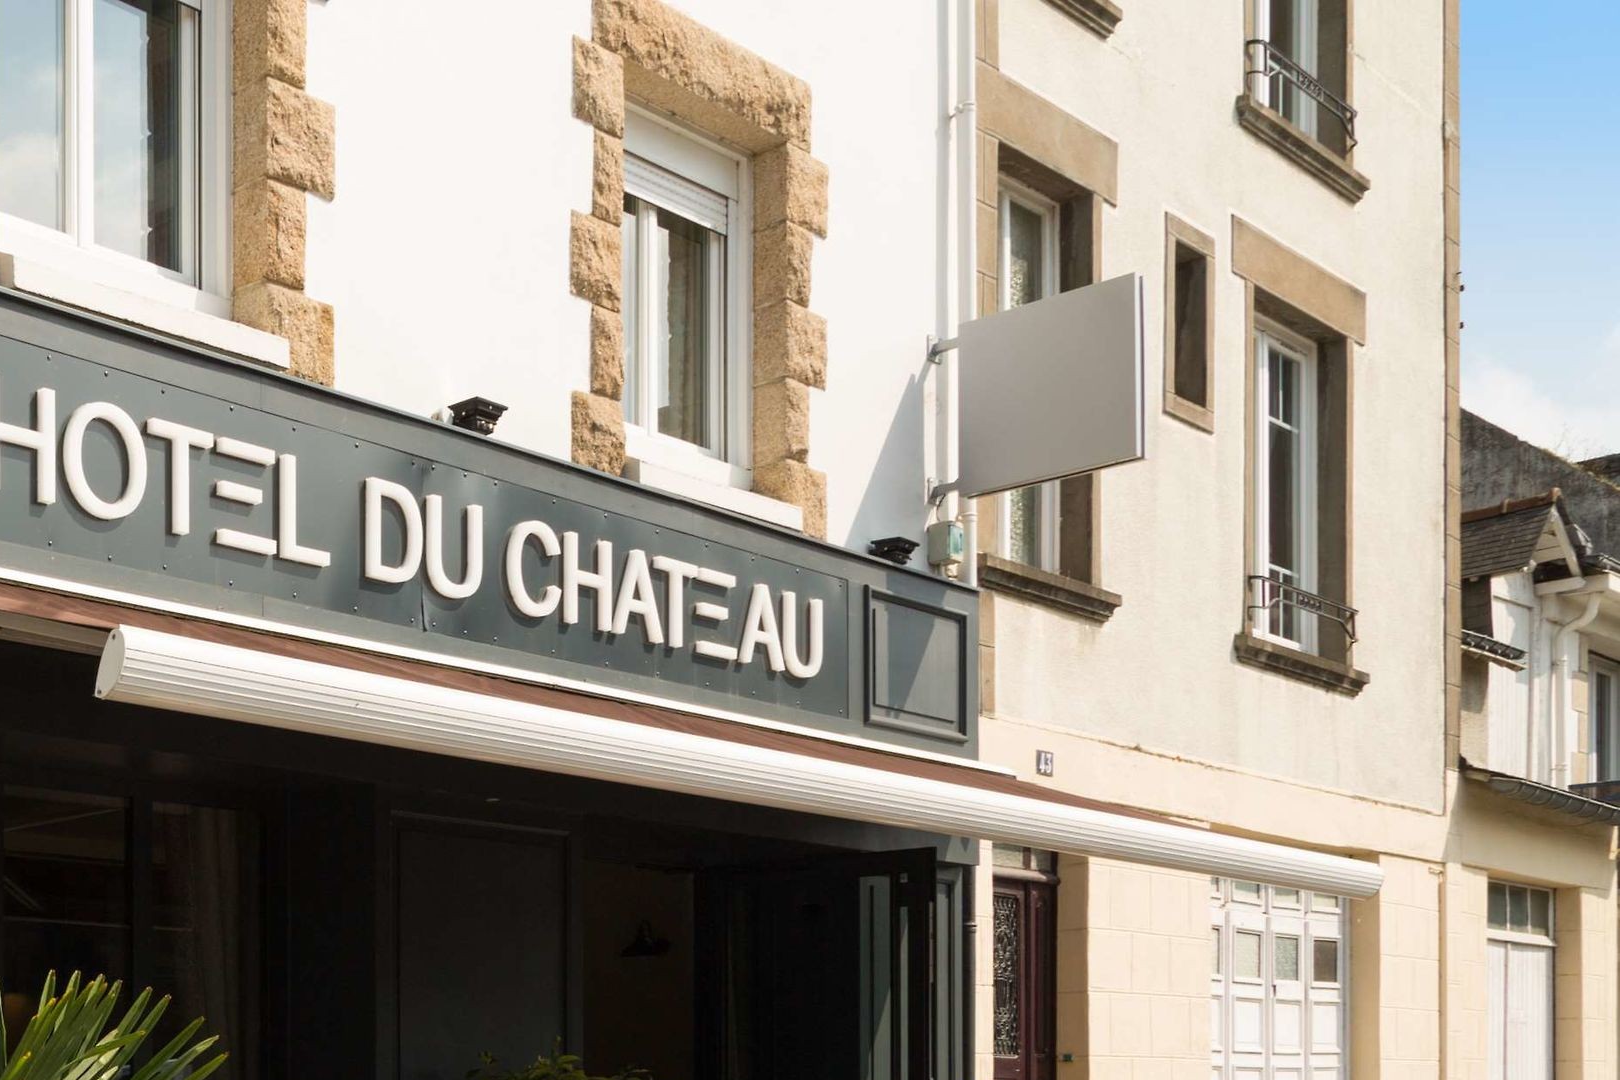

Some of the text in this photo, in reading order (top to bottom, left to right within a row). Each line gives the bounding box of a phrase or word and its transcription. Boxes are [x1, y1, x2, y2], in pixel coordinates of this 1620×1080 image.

[364, 476, 484, 600] DU
[506, 519, 824, 679] CHATEAU
[1038, 752, 1052, 774] 43
